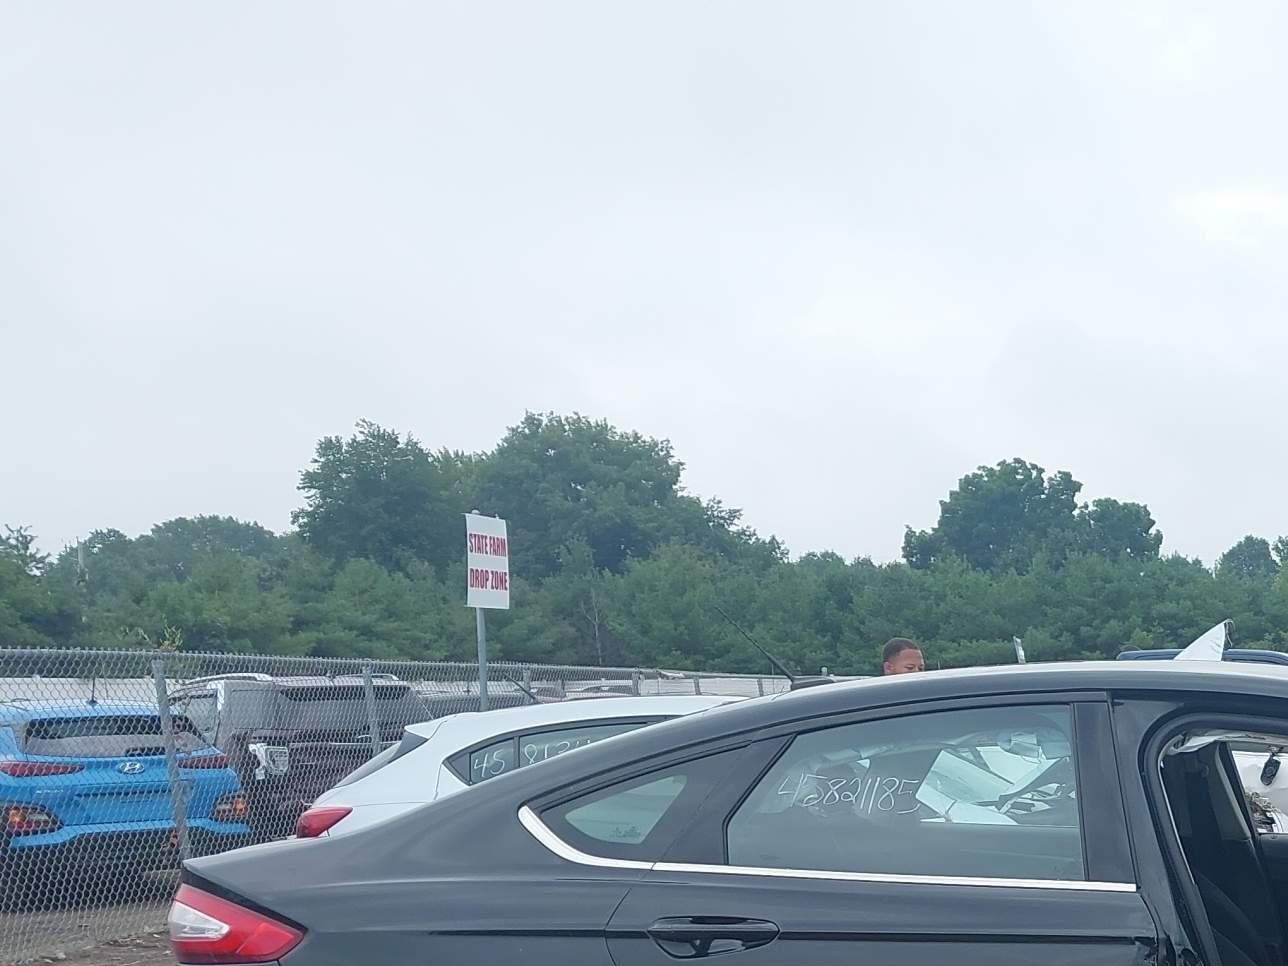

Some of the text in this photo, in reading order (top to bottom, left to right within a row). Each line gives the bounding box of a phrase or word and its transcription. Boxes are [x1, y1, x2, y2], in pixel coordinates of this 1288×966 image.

[468, 532, 507, 557] STATE FARM
[469, 567, 508, 592] DROP ZONE
[473, 749, 505, 779] 45
[777, 769, 923, 816] 45821185
